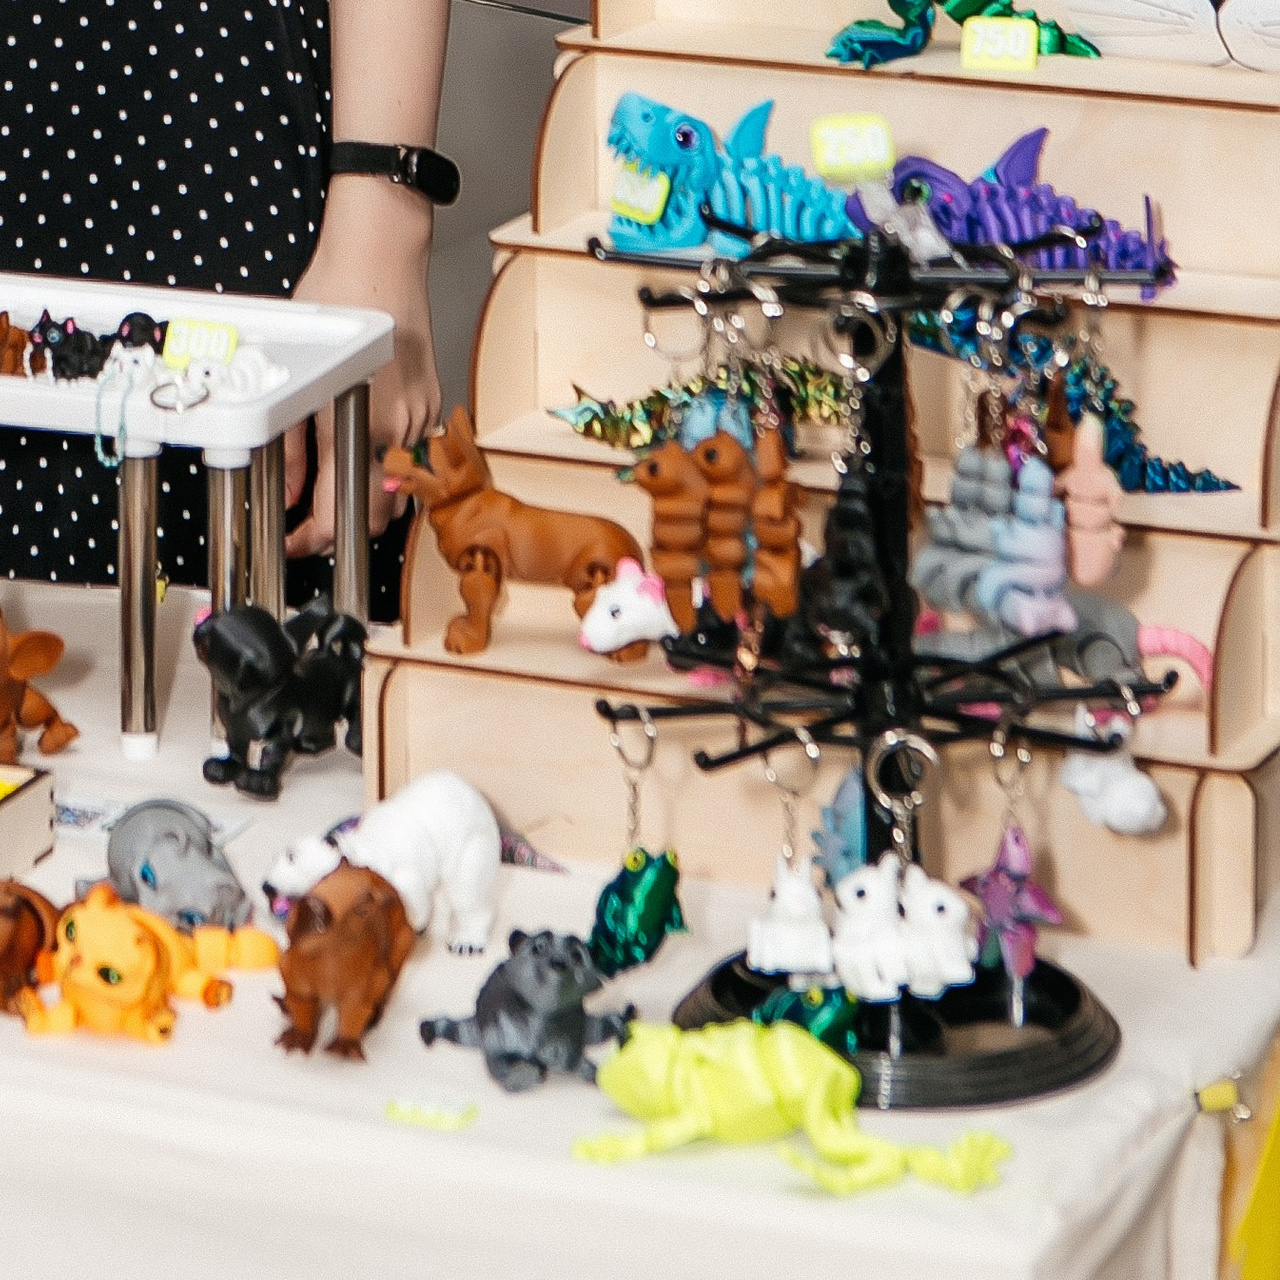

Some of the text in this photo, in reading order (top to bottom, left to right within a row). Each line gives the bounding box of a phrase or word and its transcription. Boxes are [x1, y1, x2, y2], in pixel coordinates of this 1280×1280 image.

[969, 21, 1029, 60] 750
[820, 123, 888, 165] 750
[169, 323, 231, 362] 300
